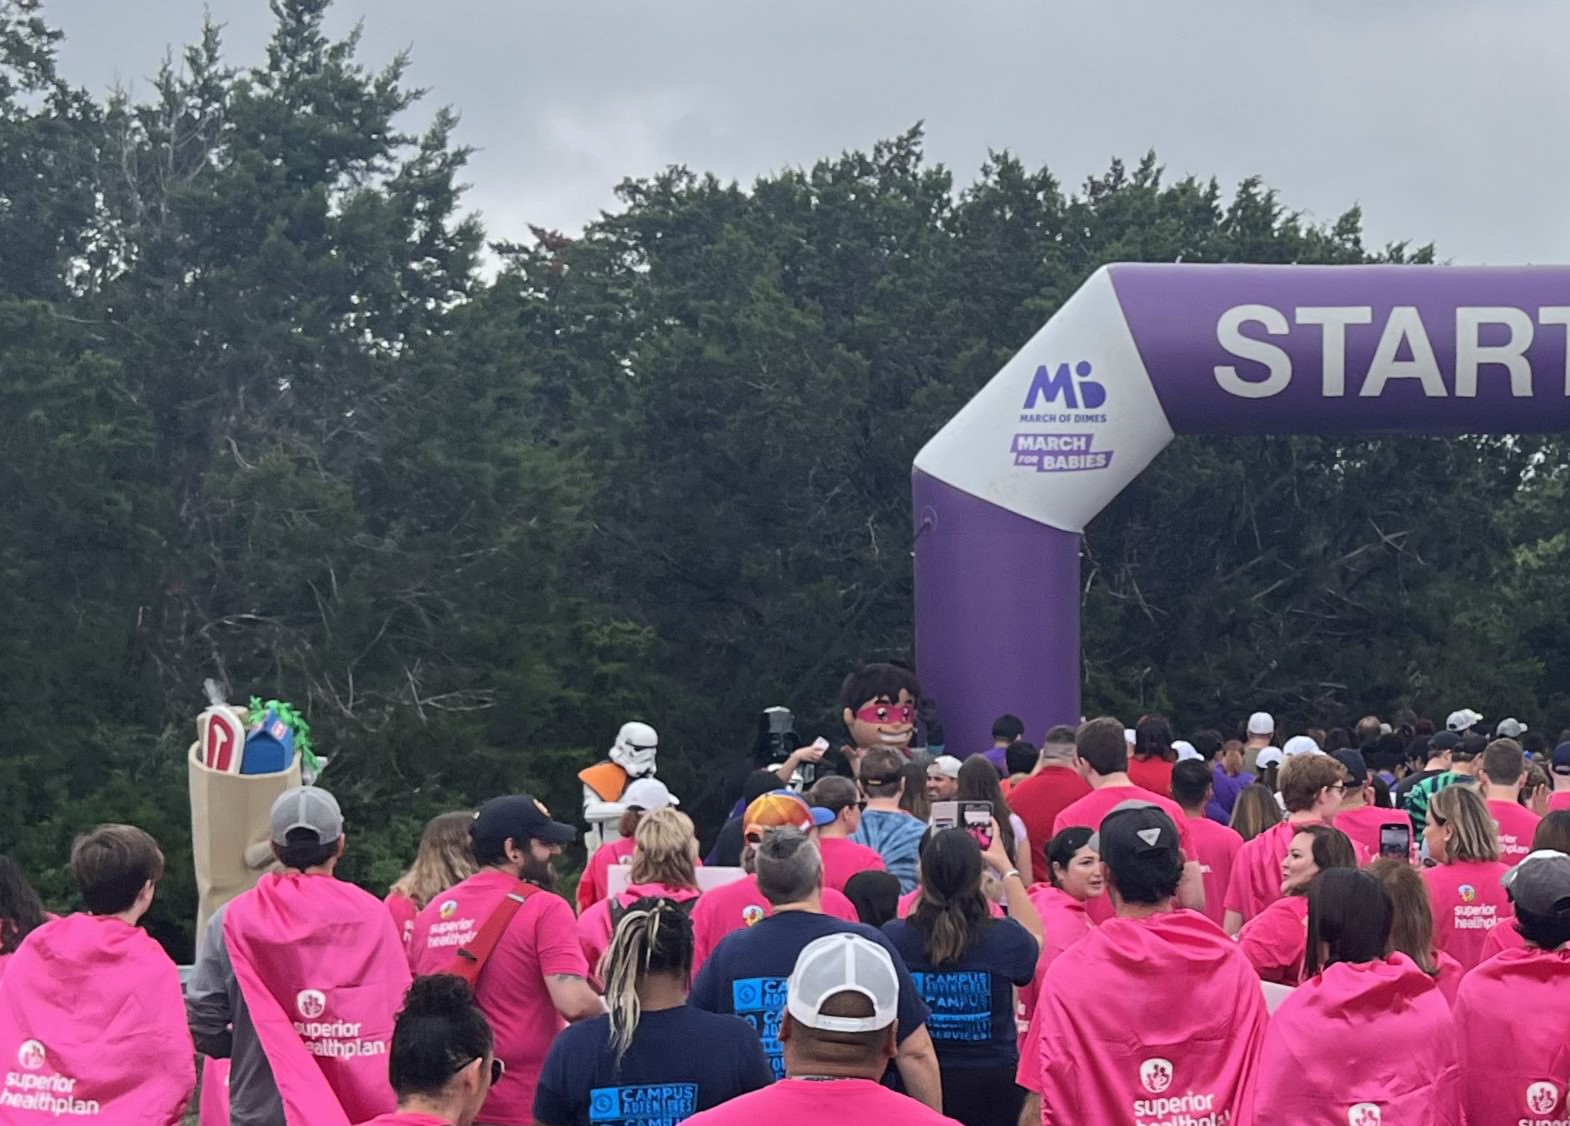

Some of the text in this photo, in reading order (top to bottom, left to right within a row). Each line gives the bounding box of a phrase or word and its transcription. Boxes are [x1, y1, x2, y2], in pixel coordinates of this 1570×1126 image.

[1020, 414, 1107, 423] MARCH OF DIMES
[1017, 436, 1086, 451] MARCH
[1044, 454, 1106, 470] BABIES
[1454, 904, 1496, 917] superior
[305, 1038, 386, 1060] ealthplan
[5, 1072, 76, 1093] superior
[0, 1087, 100, 1117] healthplan
[622, 1085, 694, 1102] CAMPUS
[1133, 1090, 1214, 1120] superior
